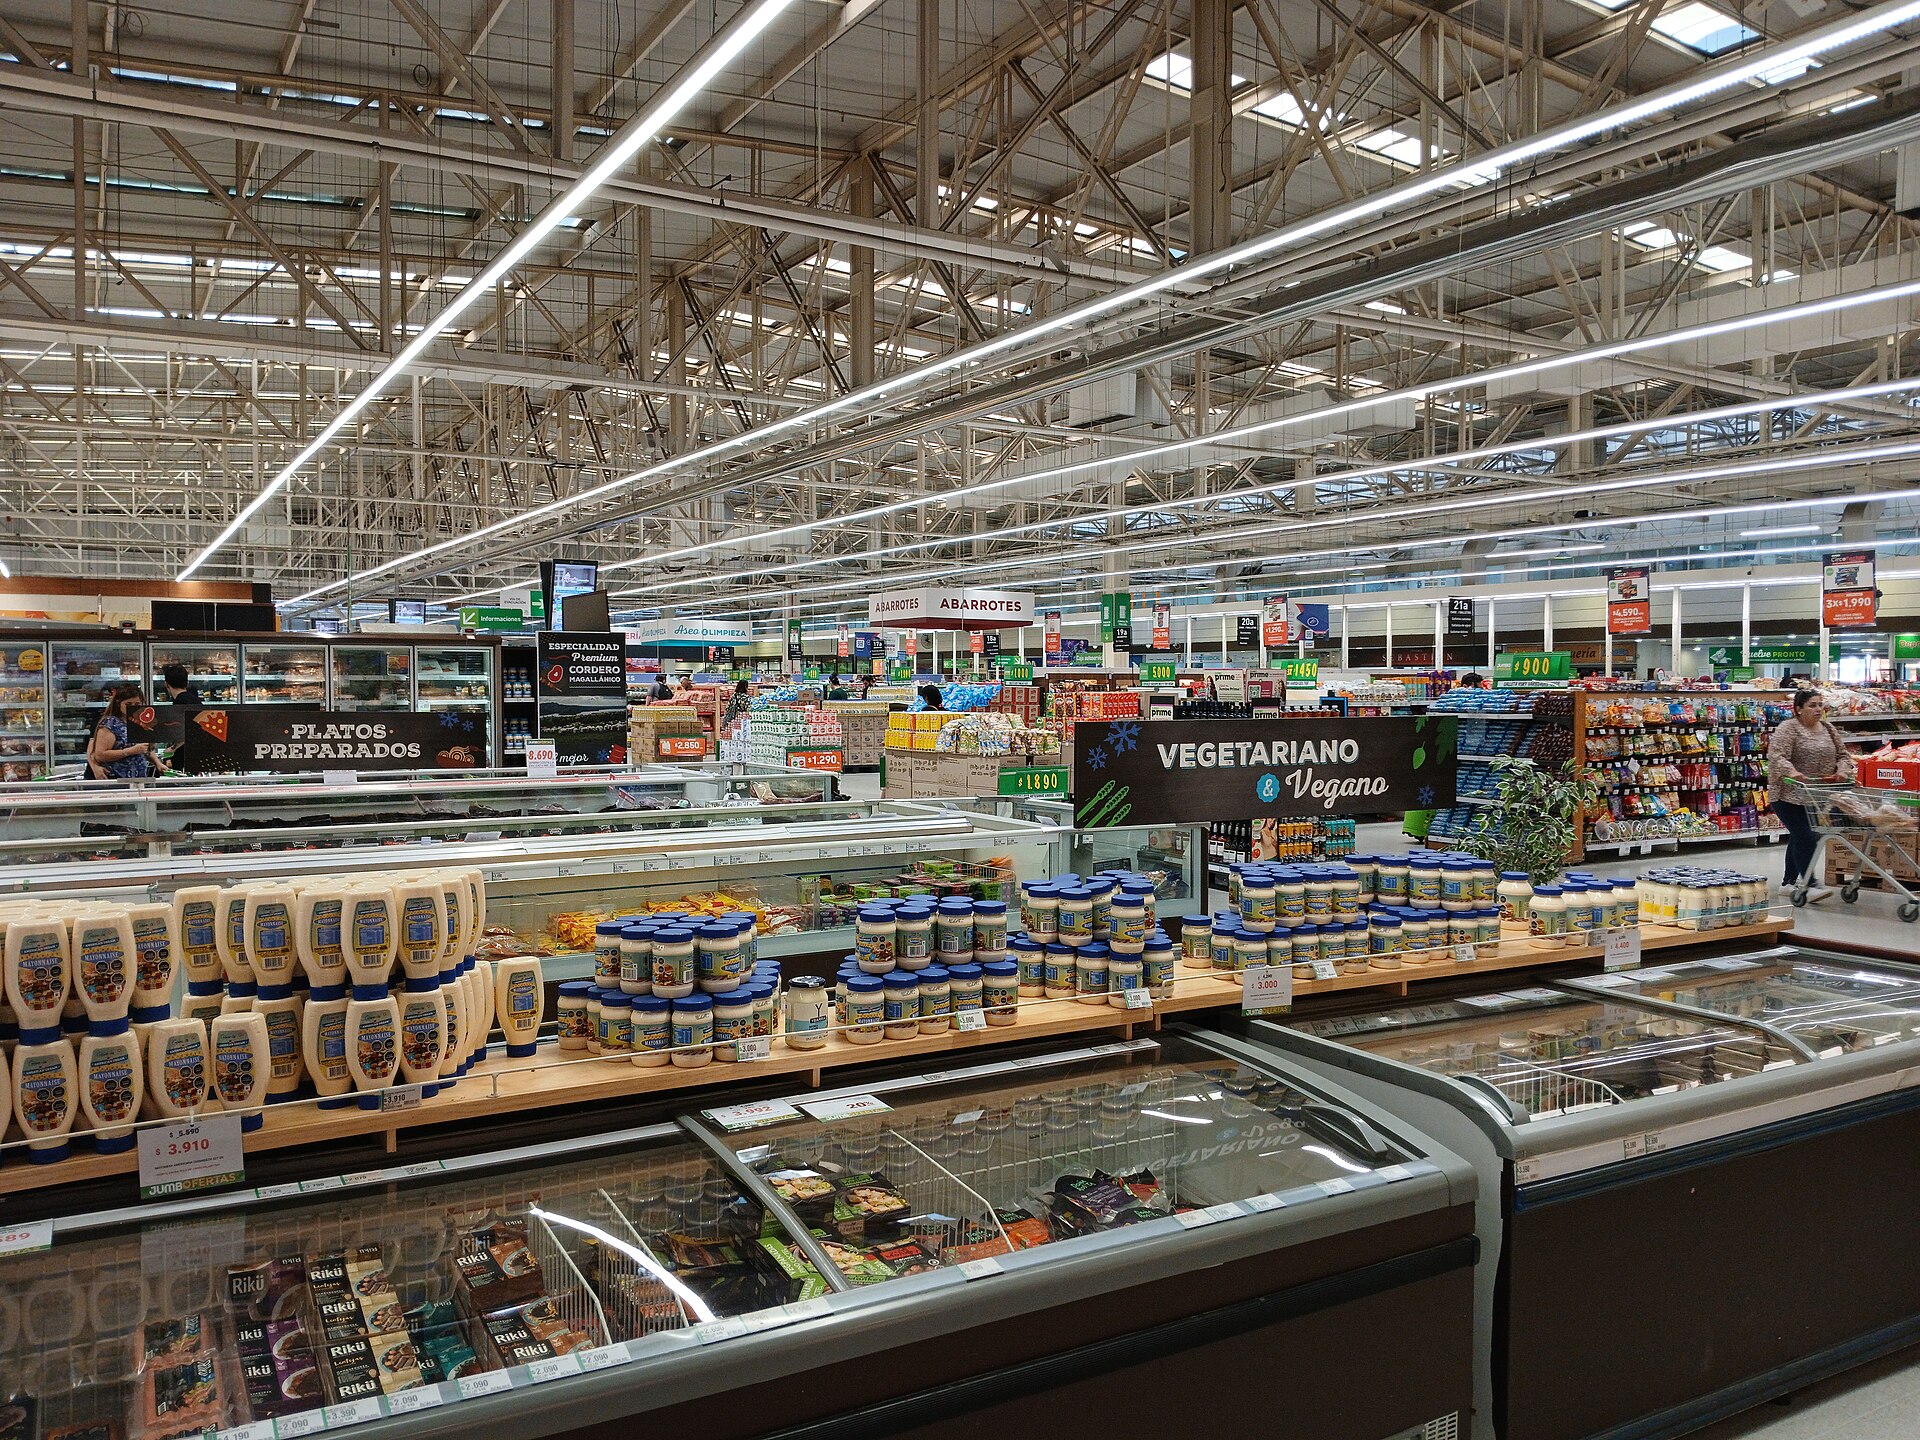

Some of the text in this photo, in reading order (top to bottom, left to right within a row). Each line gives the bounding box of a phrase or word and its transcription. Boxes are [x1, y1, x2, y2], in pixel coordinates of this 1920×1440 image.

[875, 598, 919, 613] ABARROTES
[939, 598, 1022, 612] ABARROTES
[1453, 600, 1469, 610] 21a
[480, 615, 521, 623] Informaciones
[1241, 617, 1254, 626] 20a
[674, 624, 699, 636] Aseo
[708, 629, 747, 637] LIMPIEZA
[1116, 628, 1128, 636] 19a
[548, 642, 620, 651] ESPECIALIDAD
[571, 652, 619, 662] Premium
[1772, 650, 1805, 658] PRONTO
[568, 665, 621, 674] CORDERO
[1514, 657, 1549, 675] $ 900
[569, 675, 621, 683] MAGALLÁNICO
[1151, 708, 1172, 717] prime
[291, 723, 387, 740] PLATOS
[254, 742, 421, 760] PREPARADOS
[528, 750, 553, 760] 8.690
[1157, 738, 1358, 769] VEGETARIANO
[559, 753, 589, 766] mejor
[807, 755, 837, 765] $1.290
[1878, 769, 1902, 777] hanuta
[1262, 767, 1389, 810] & Vegano
[137, 940, 166, 950] AYONNAISE
[84, 950, 120, 961] MAYONNAISE
[22, 957, 59, 968] MAYONNAISE
[1257, 980, 1278, 989] 3.000
[361, 1032, 392, 1041] MAYONNAISE
[168, 1056, 200, 1067] MAYONNAISE
[93, 1069, 128, 1079] MAYONNAISE
[25, 1079, 61, 1089] MAYONNAISE
[846, 1100, 874, 1110] 20%
[732, 1105, 773, 1118] 3.992
[168, 1138, 210, 1155] 3.910
[149, 1172, 236, 1196] JUMBOFERTAS
[456, 1252, 489, 1267] Rikü
[310, 1267, 343, 1281] Rikü
[232, 1274, 265, 1295] Rikü
[322, 1300, 357, 1314] Rikü
[494, 1329, 529, 1344] Rikü
[330, 1341, 367, 1357] Rikü
[513, 1342, 549, 1358] Rikü
[417, 1359, 435, 1370] kü
[338, 1380, 377, 1397] Rikü
